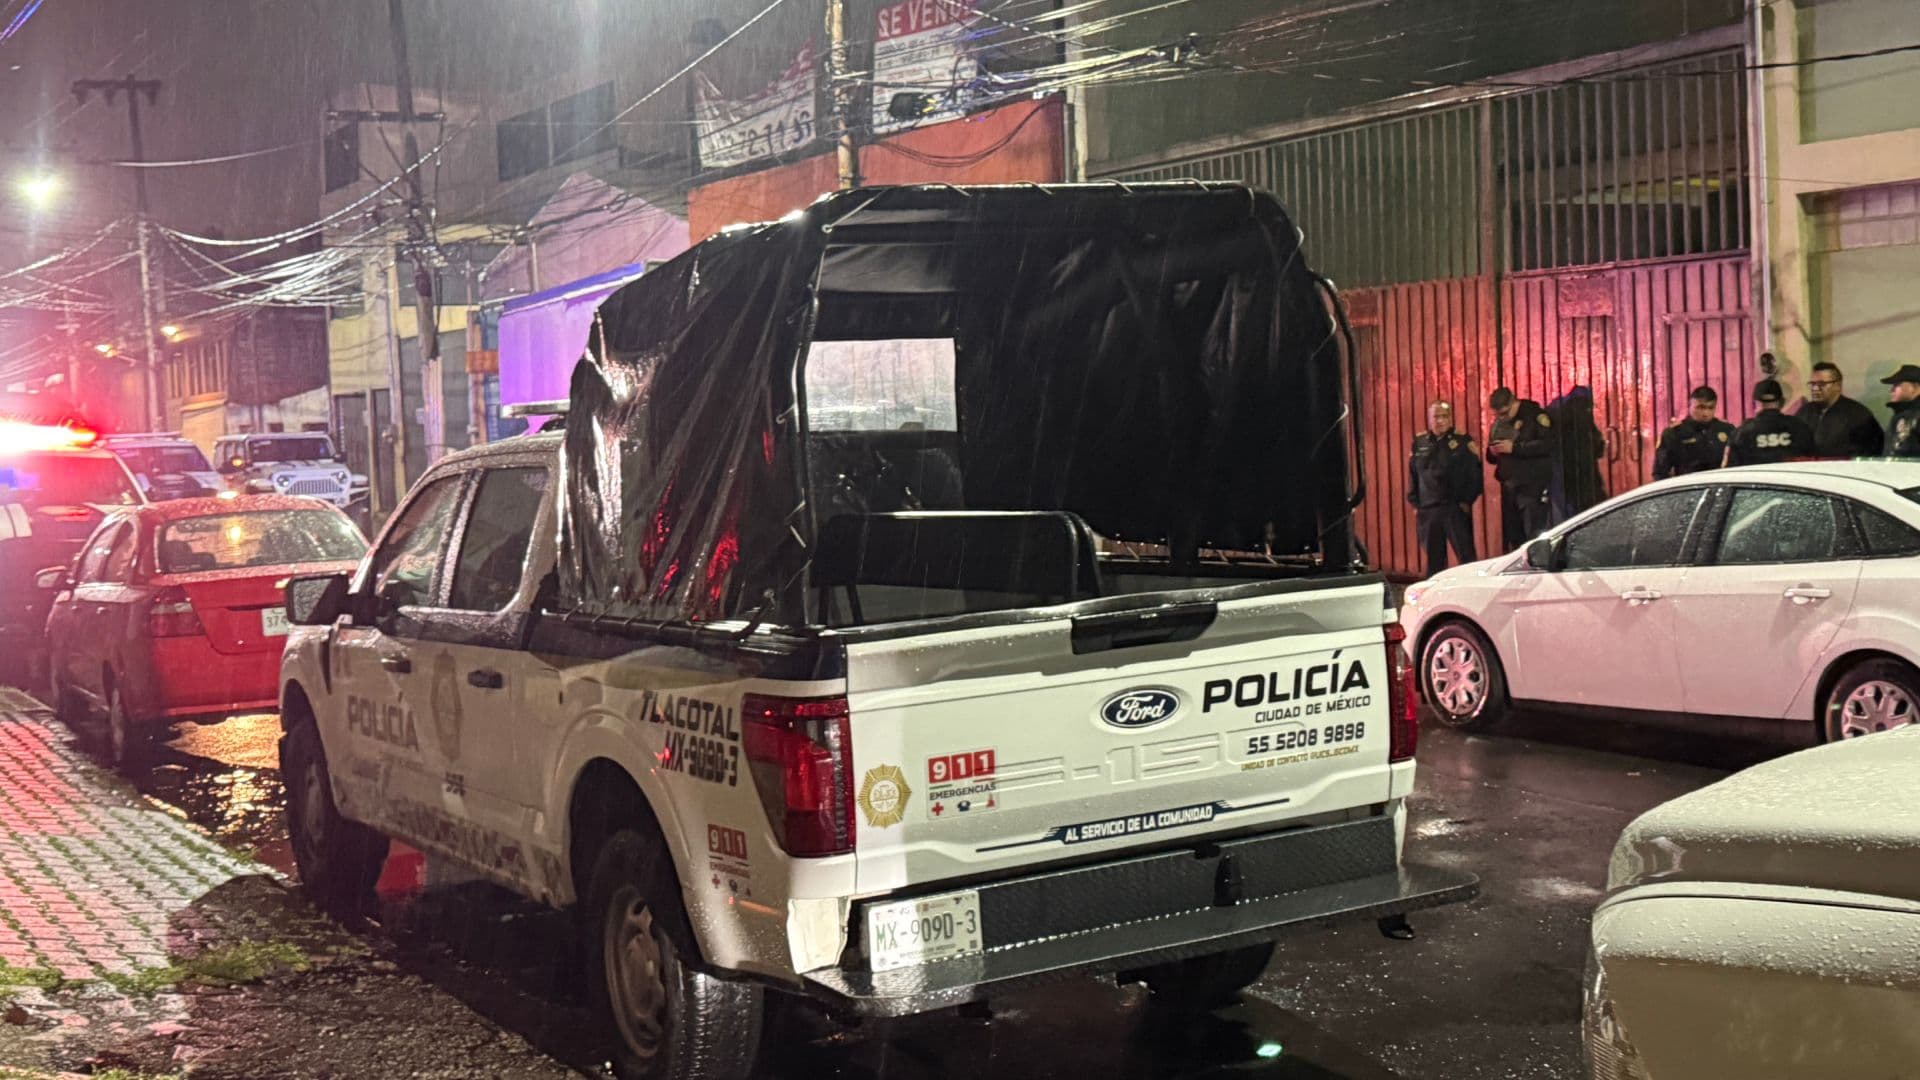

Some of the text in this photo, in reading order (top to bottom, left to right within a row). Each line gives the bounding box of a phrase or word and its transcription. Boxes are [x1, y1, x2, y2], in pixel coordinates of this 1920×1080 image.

[878, 6, 903, 38] SE
[1756, 432, 1792, 448] SSC
[1202, 648, 1370, 713] POLICÍA
[348, 690, 420, 753] POLICÍA
[640, 690, 739, 742] TLACOTAL
[1116, 695, 1166, 723] Ford
[1255, 695, 1371, 723] CIUDAD DE MÉXICO
[1246, 721, 1365, 755] 55 5208 9898
[931, 753, 990, 780] 911
[929, 783, 996, 801] EMERGENCIAS
[1065, 805, 1213, 842] AL SERVICIO DE LA COMUNIDAD
[710, 829, 744, 855] 911
